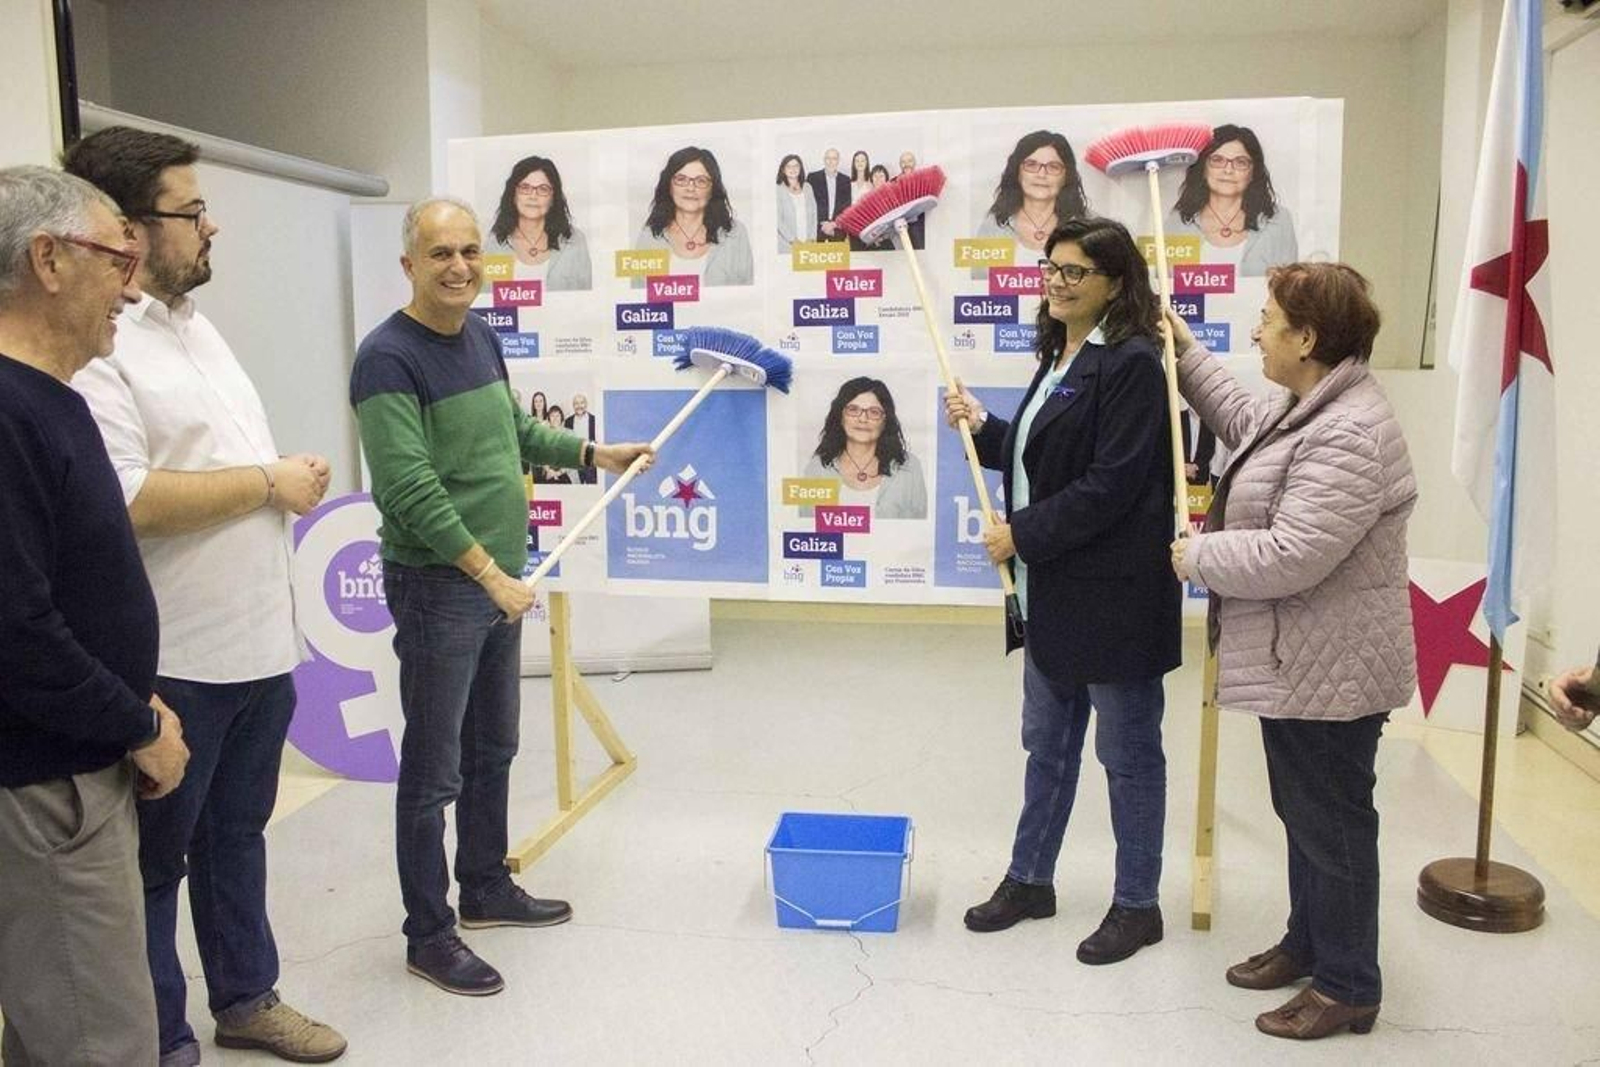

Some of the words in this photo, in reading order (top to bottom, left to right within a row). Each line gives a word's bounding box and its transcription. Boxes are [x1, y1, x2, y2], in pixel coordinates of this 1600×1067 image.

[799, 250, 844, 264] Facer
[961, 245, 1008, 260] Facer
[1145, 243, 1194, 257] Fcer
[622, 256, 664, 270] Facer
[833, 275, 876, 291] Valer
[996, 273, 1040, 288] Valer
[1181, 270, 1228, 287] Valer
[498, 286, 537, 301] Valer
[653, 281, 694, 297] Valer
[621, 308, 668, 323] Galiza
[799, 305, 849, 318] Galiza
[960, 302, 1013, 317] Galiza
[657, 333, 674, 343] Con
[837, 330, 854, 339] Con
[856, 330, 874, 339] Voz
[999, 328, 1018, 338] Con
[502, 337, 519, 346] Con
[779, 338, 800, 351] bng
[837, 339, 867, 349] Propia
[953, 336, 975, 349] bng
[503, 346, 530, 356] Propia
[789, 485, 833, 499] Facer
[528, 506, 557, 520] aler
[822, 511, 864, 527] Valer
[621, 492, 718, 551] bng
[789, 538, 838, 552] Galiza
[825, 564, 843, 574] Con
[844, 564, 862, 574] Voz
[825, 574, 855, 585] Propia
